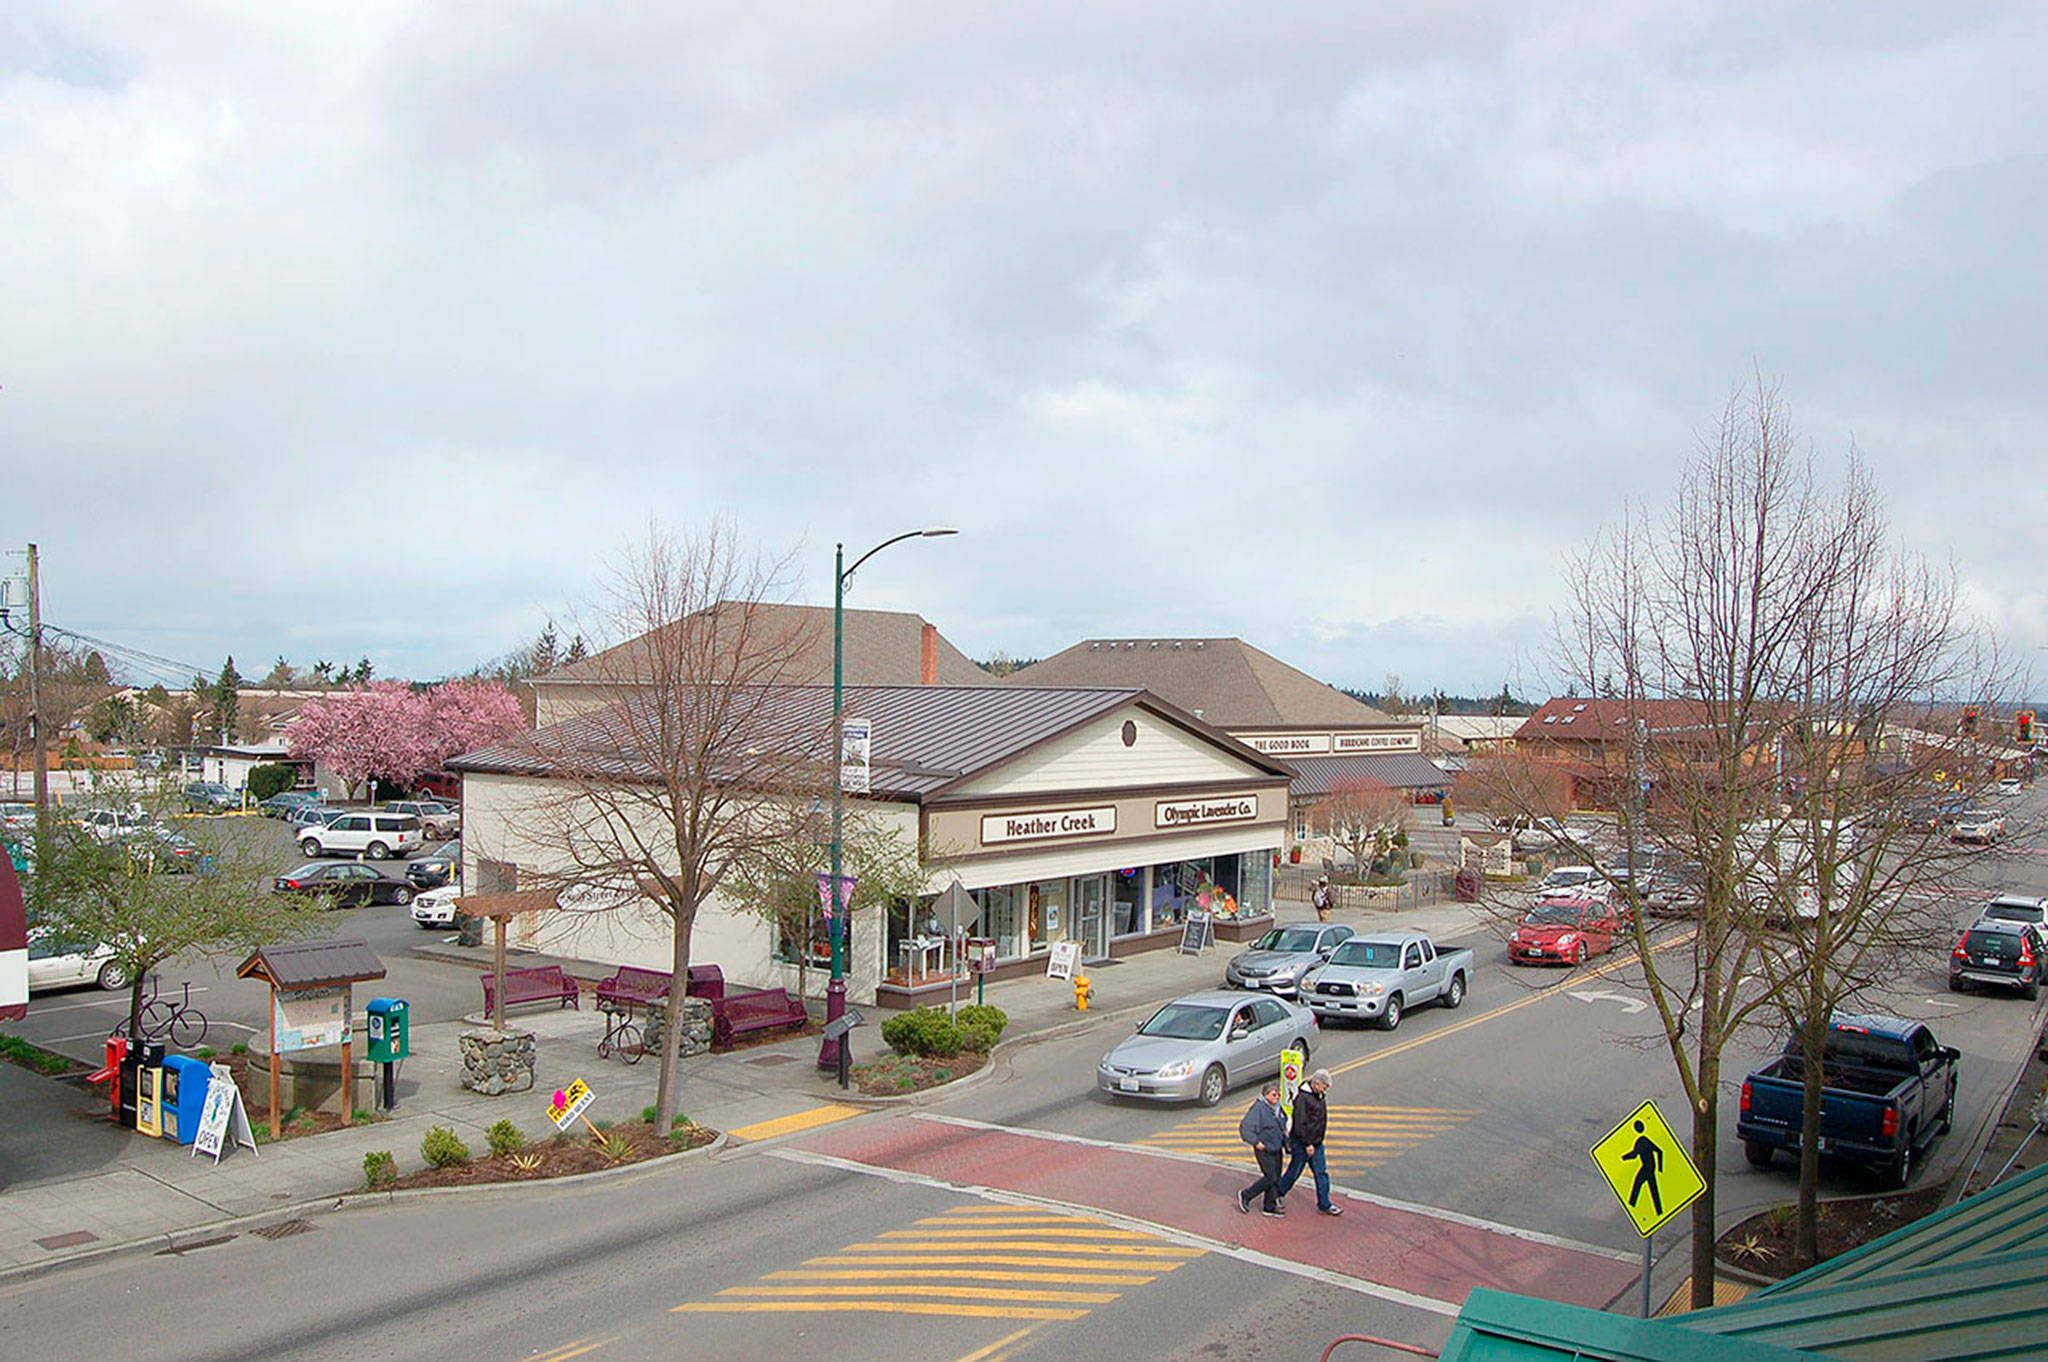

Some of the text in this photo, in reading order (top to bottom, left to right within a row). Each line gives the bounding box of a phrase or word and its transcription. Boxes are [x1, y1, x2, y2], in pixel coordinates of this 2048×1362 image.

[1269, 739, 1289, 750] GOOD
[1291, 739, 1310, 749] BOOK
[1165, 801, 1252, 824] Olympic Lavender Co.
[1006, 813, 1096, 837] Heather Creek
[198, 1130, 219, 1150] OPEN
